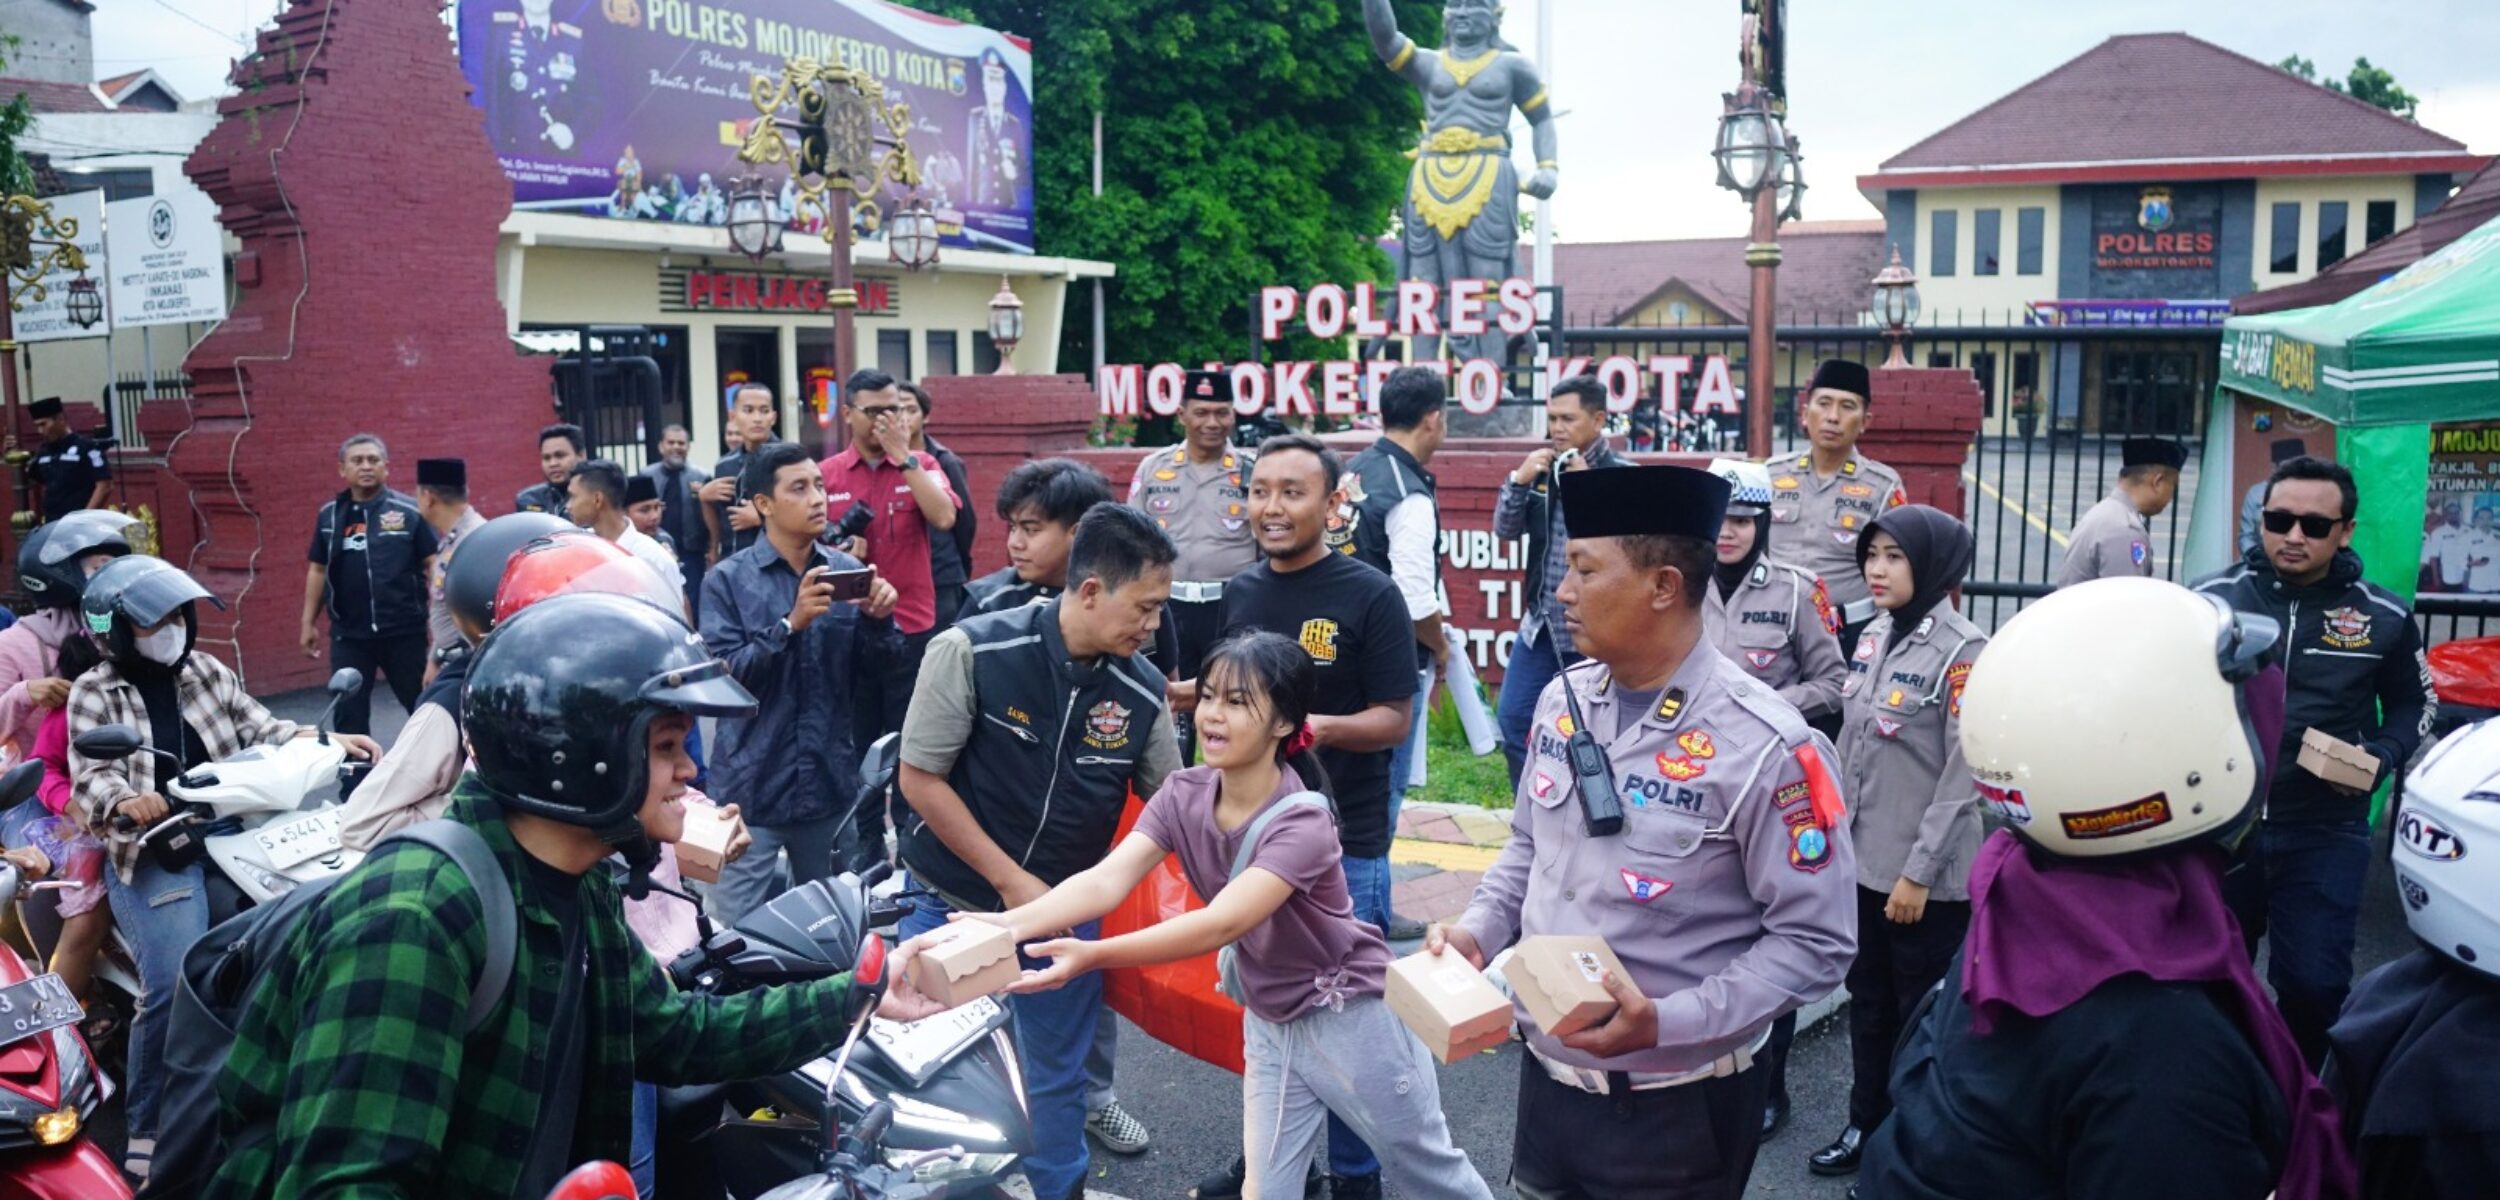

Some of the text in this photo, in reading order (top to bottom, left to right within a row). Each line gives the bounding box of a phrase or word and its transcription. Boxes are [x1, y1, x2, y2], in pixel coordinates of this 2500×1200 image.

[647, 0, 946, 91] POLRES MOJOKERTO KOTA
[2098, 232, 2213, 254] POLRES
[689, 271, 889, 310] PENJAGAN
[1261, 277, 1537, 340] POLRES
[2272, 336, 2315, 392] HEMAT
[1835, 497, 1873, 511] POLRI
[1741, 611, 1788, 625] POLRI
[1889, 671, 1926, 688] POLRI
[1623, 773, 1704, 811] POLRI
[31, 976, 65, 1000] VY
